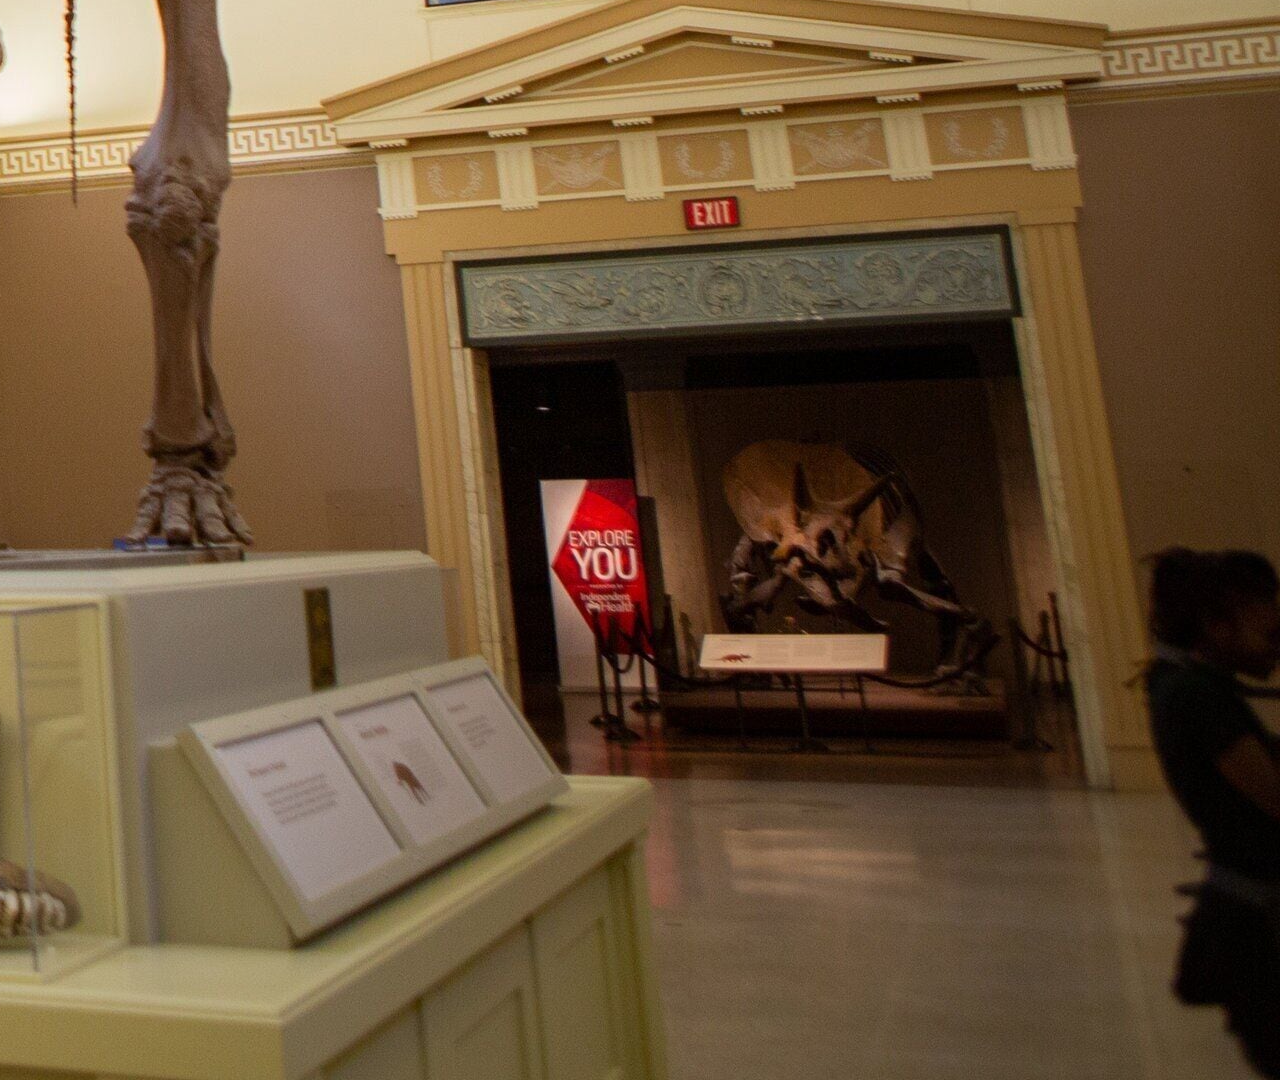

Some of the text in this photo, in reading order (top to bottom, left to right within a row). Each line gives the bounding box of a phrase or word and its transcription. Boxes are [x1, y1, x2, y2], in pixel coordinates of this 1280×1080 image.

[692, 200, 730, 225] EXIT
[568, 529, 635, 548] EXPLORE
[569, 547, 638, 581] YOU
